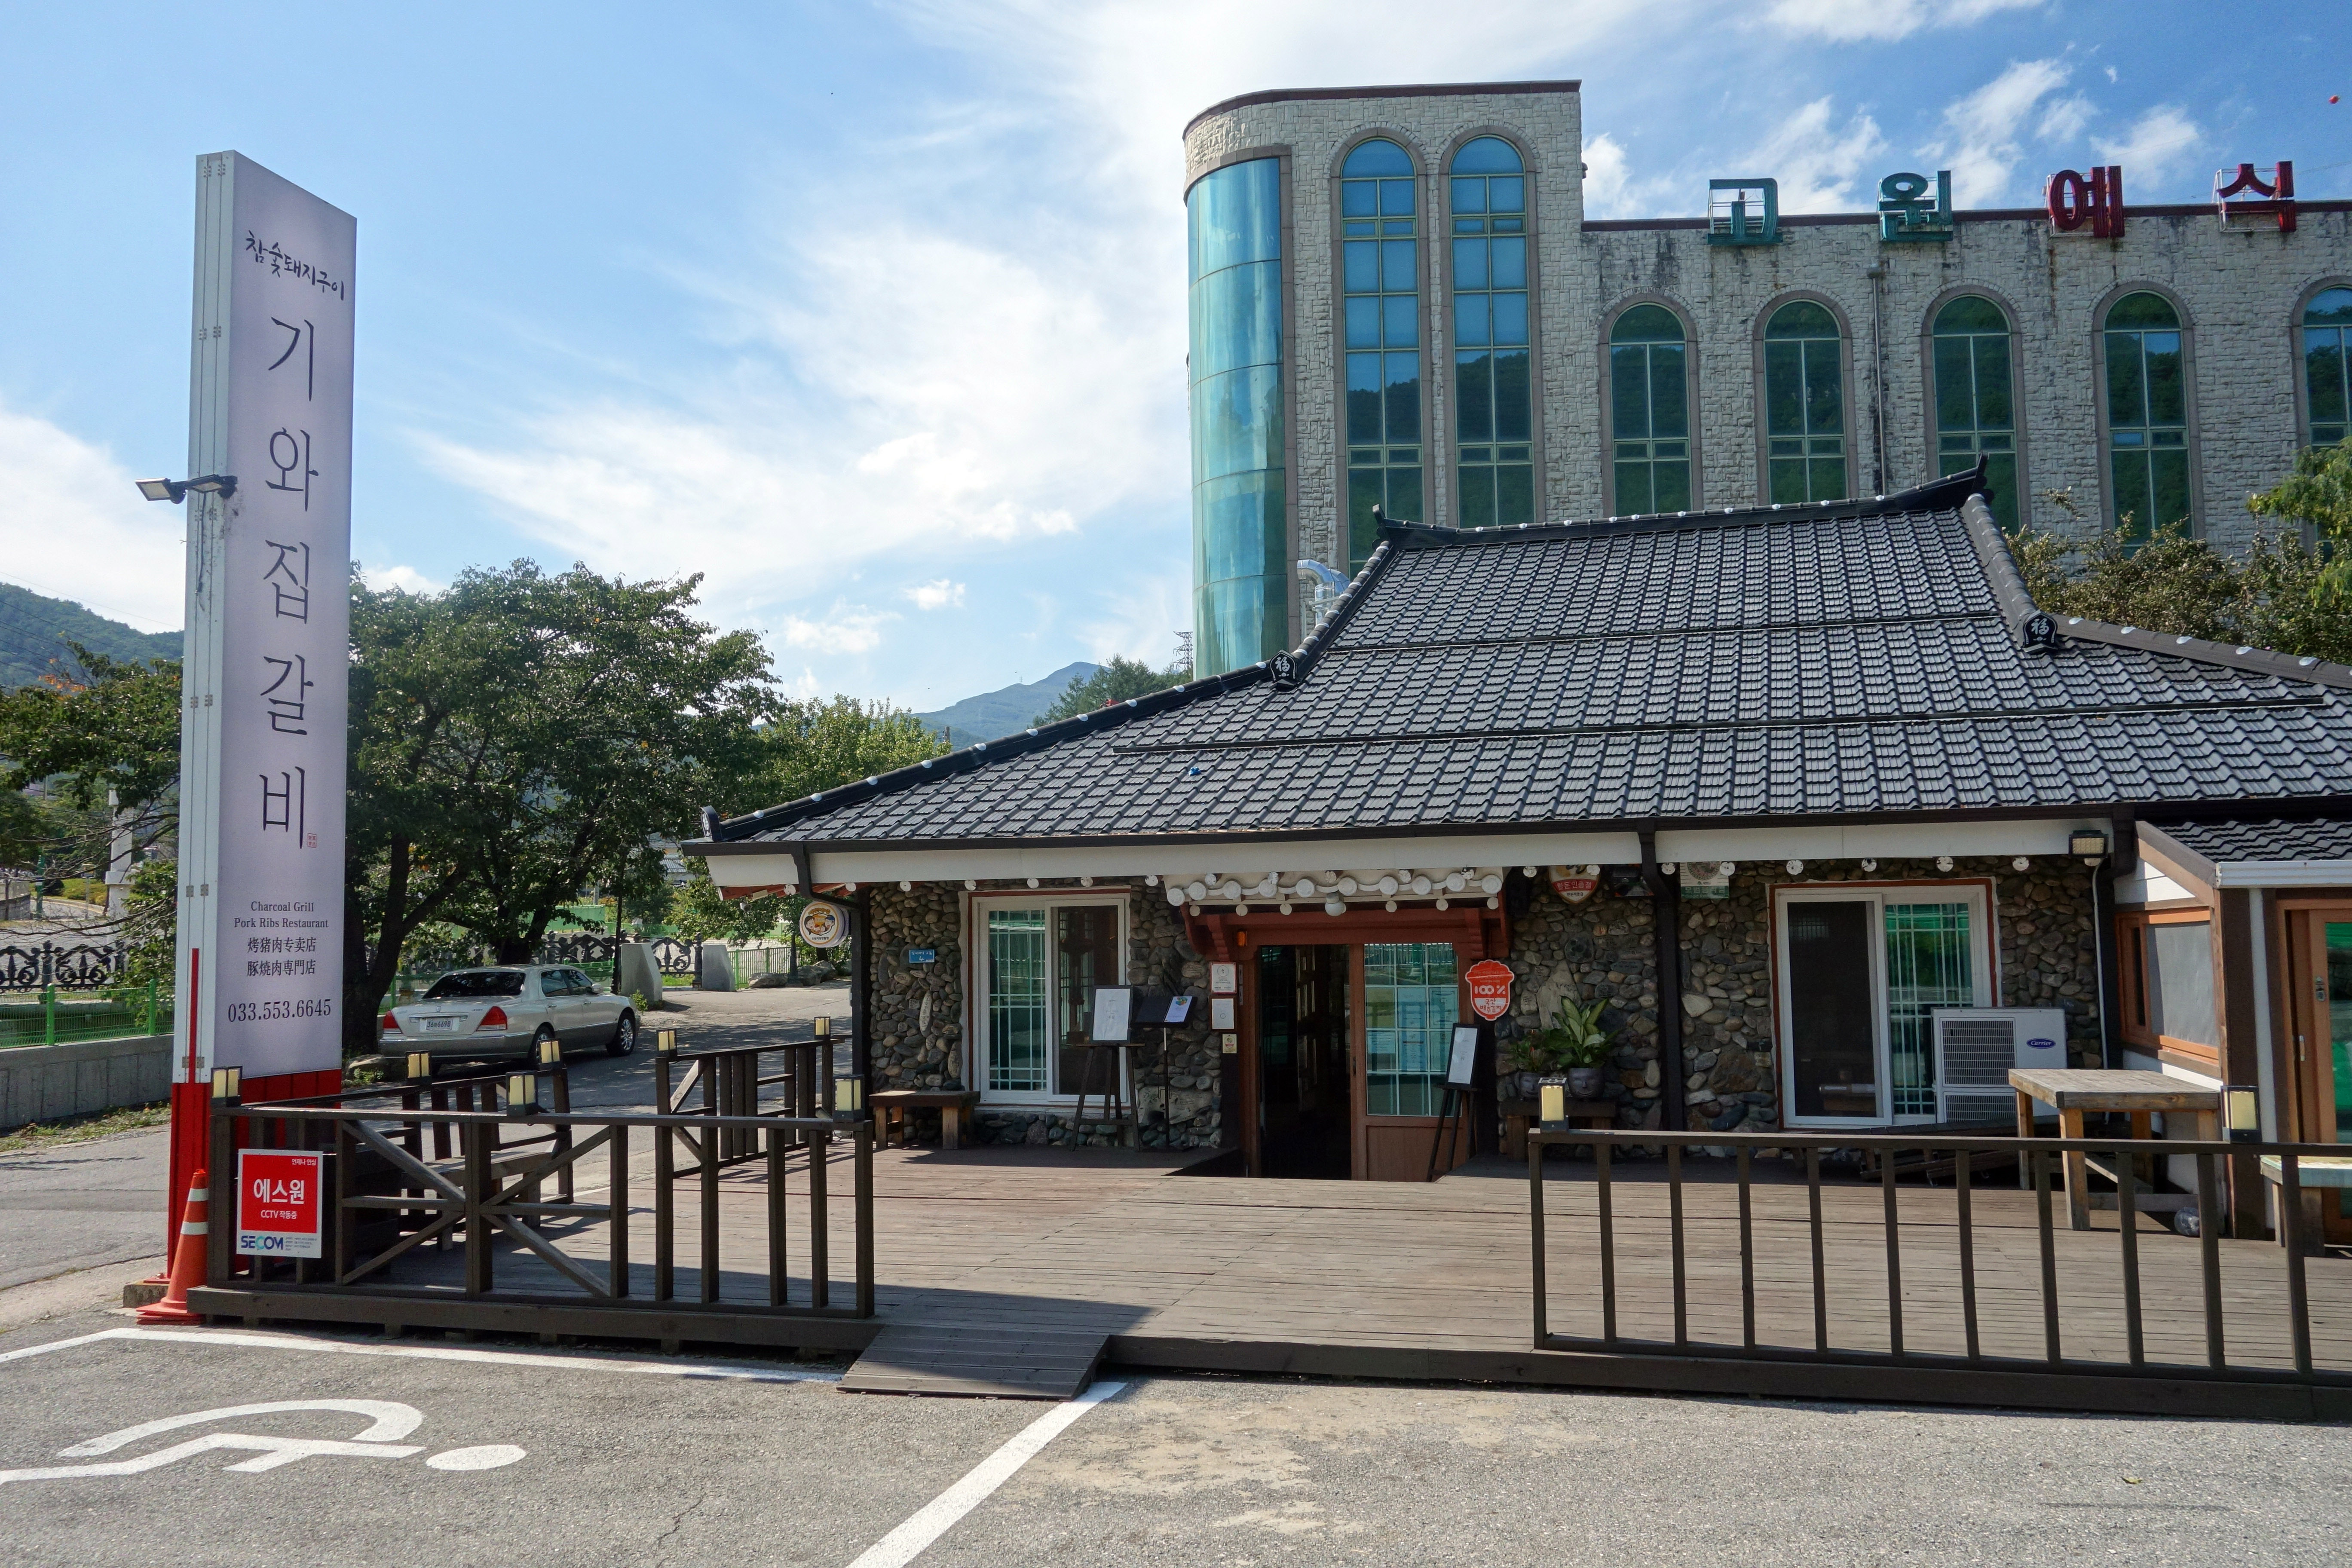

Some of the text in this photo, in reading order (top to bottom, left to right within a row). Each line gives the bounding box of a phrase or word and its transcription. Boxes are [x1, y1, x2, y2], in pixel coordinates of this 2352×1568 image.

[245, 230, 345, 301] 참숯돼지구이
[259, 317, 318, 849] 기와집갈비
[2031, 618, 2049, 635] 福
[1275, 656, 1290, 672] 福
[251, 901, 314, 912] Charcoal Grill
[234, 918, 329, 928] Pork Ribs Restaurant
[247, 937, 317, 953] 烤猪肉专卖店
[228, 998, 331, 1022] 033.553.6645
[1480, 1004, 1502, 1014] 배추김치
[253, 1178, 305, 1204] 에스원
[260, 1210, 297, 1219] CCTV 작동중
[241, 1235, 284, 1251] SECOM
